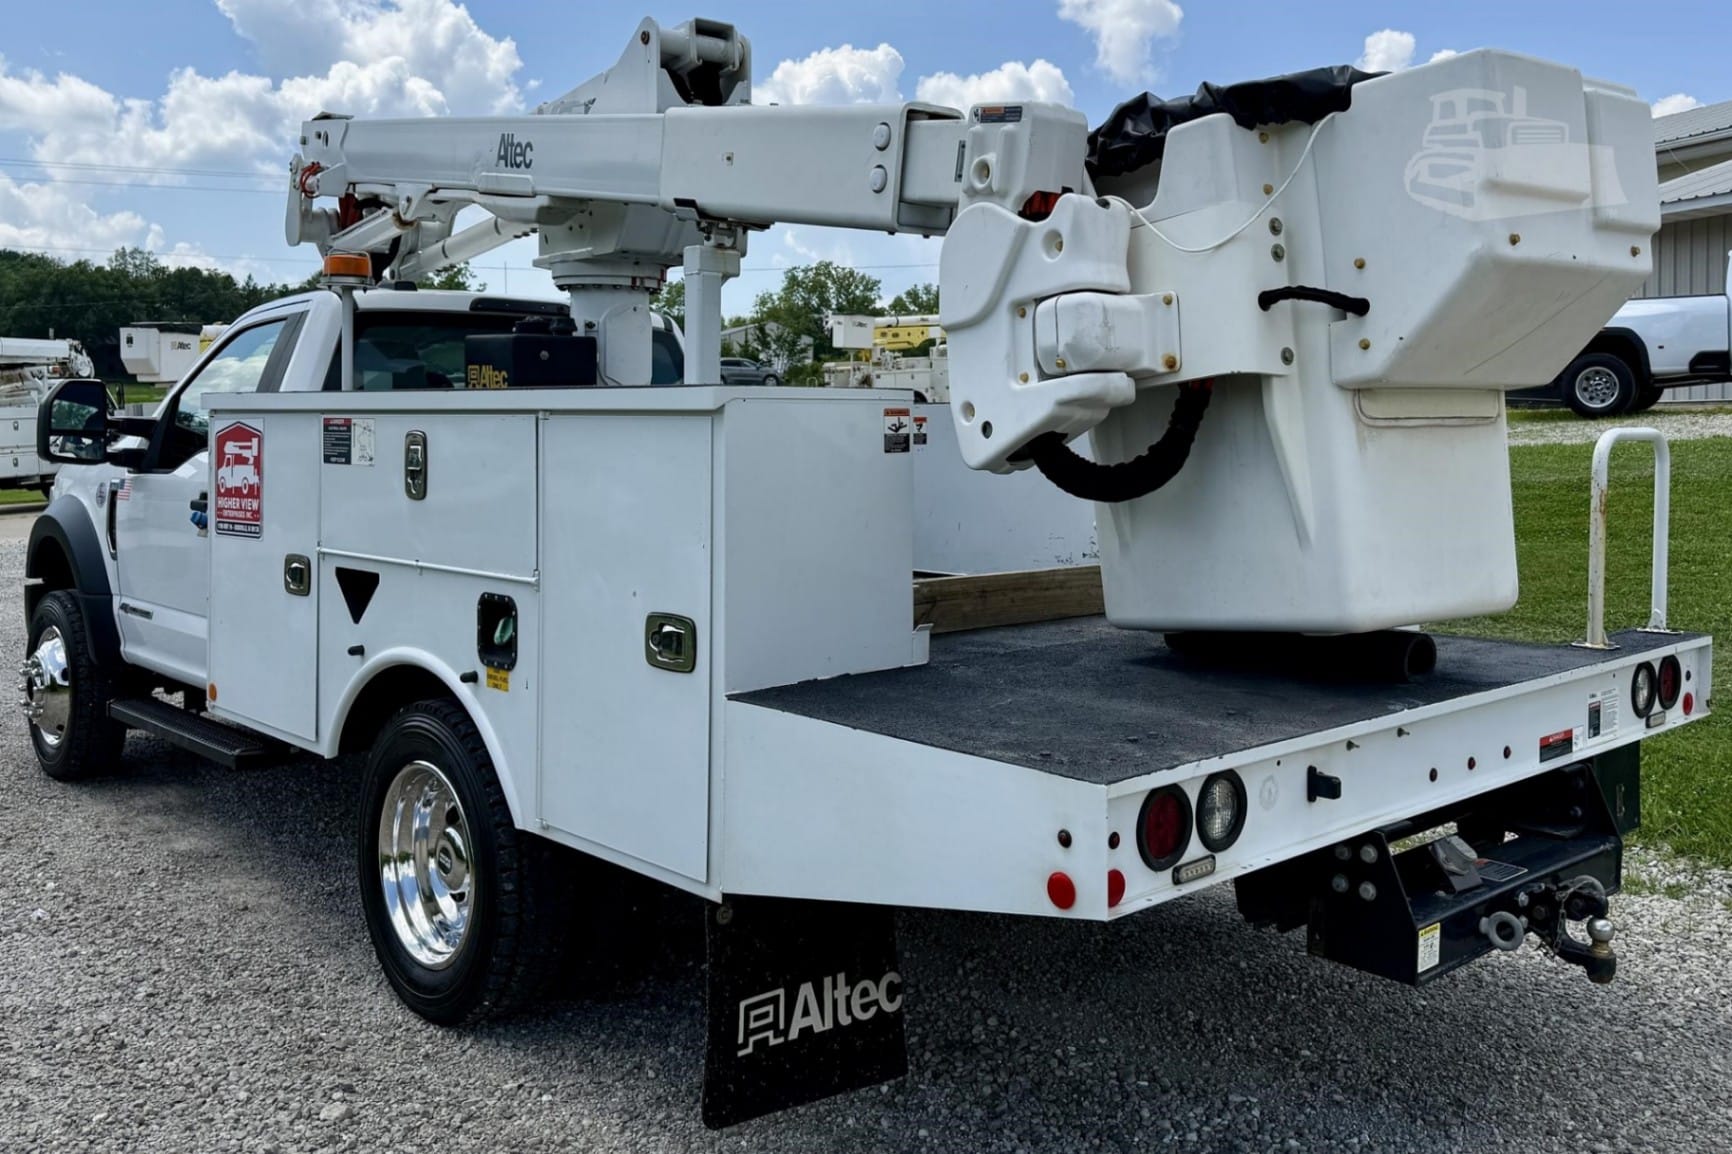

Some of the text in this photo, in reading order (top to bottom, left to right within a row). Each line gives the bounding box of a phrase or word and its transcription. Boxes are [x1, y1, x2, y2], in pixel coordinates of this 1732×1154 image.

[496, 133, 533, 169] Altec
[481, 364, 509, 389] Altec
[217, 496, 260, 512] HIGHER VIEW
[787, 971, 903, 1042] Altec
